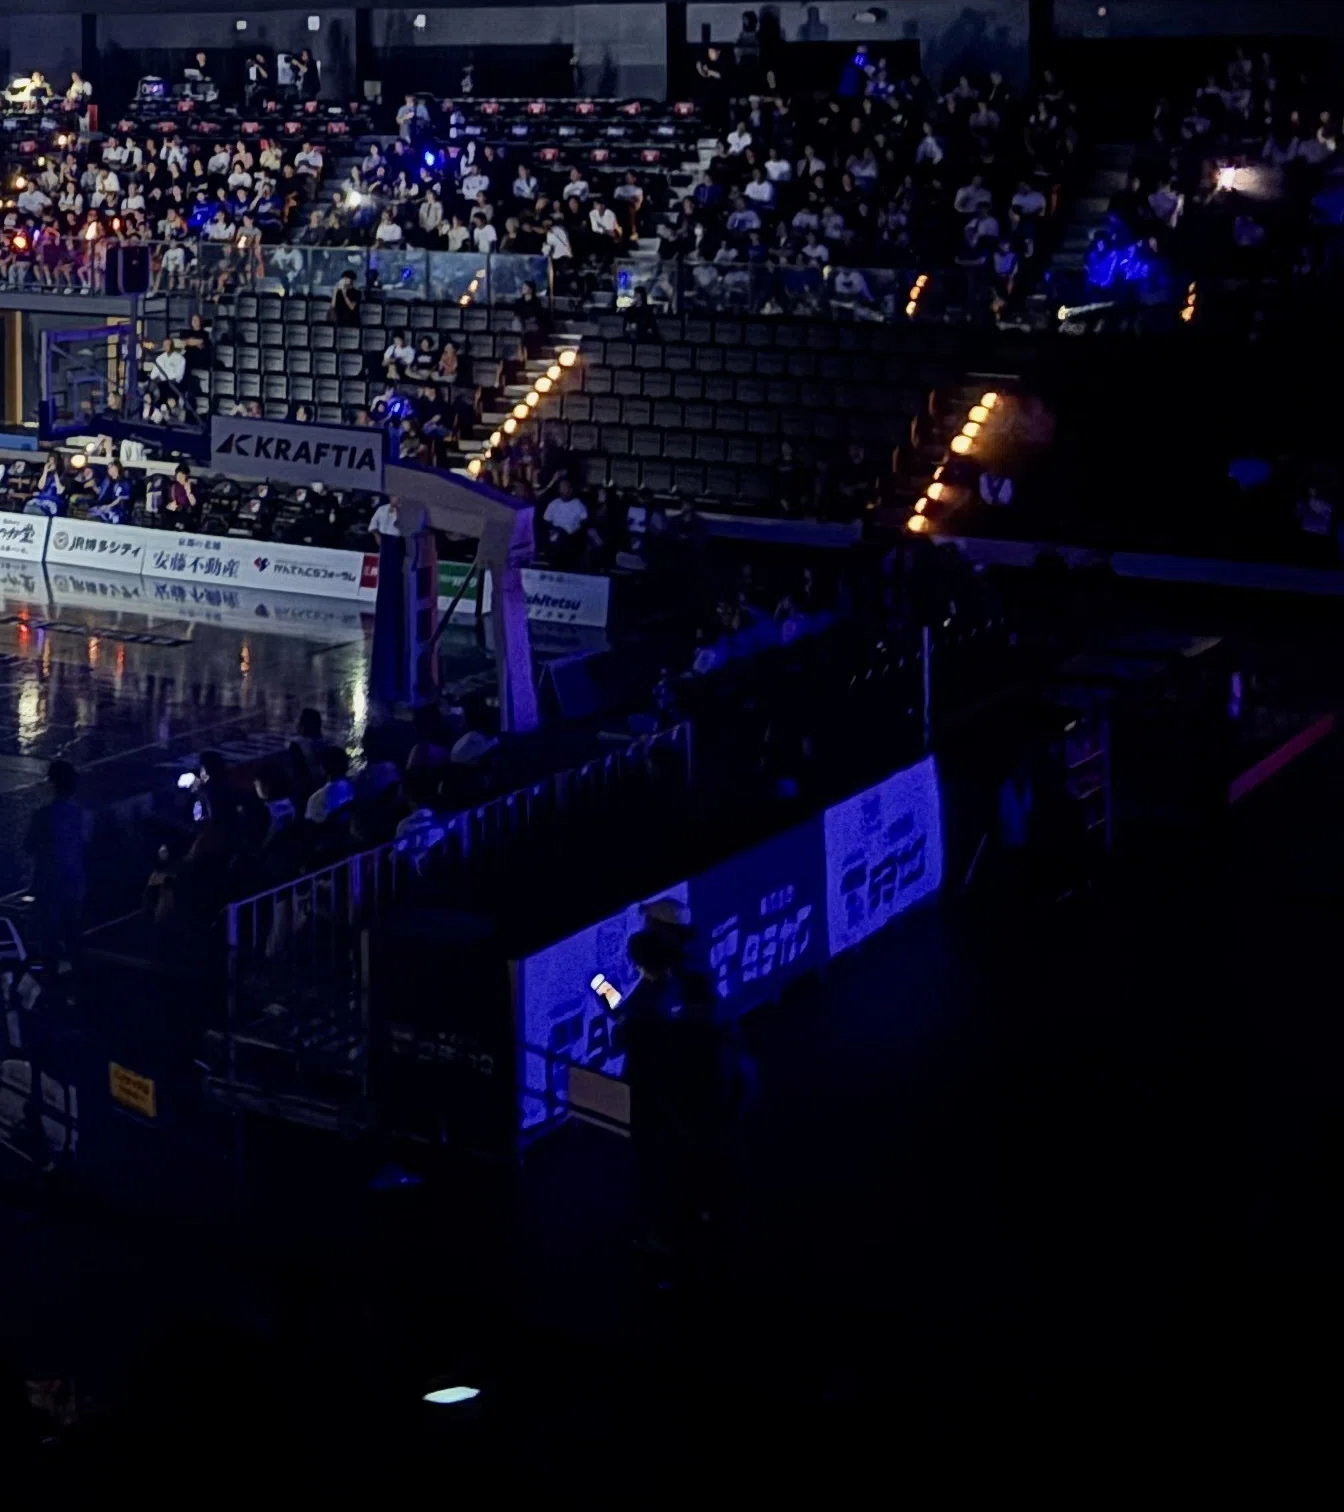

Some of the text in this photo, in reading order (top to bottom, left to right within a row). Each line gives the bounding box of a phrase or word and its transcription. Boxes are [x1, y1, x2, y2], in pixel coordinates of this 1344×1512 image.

[254, 436, 377, 472] KRAFTIA
[69, 535, 142, 558] JR博多シティ
[153, 549, 240, 578] 安藤不動産
